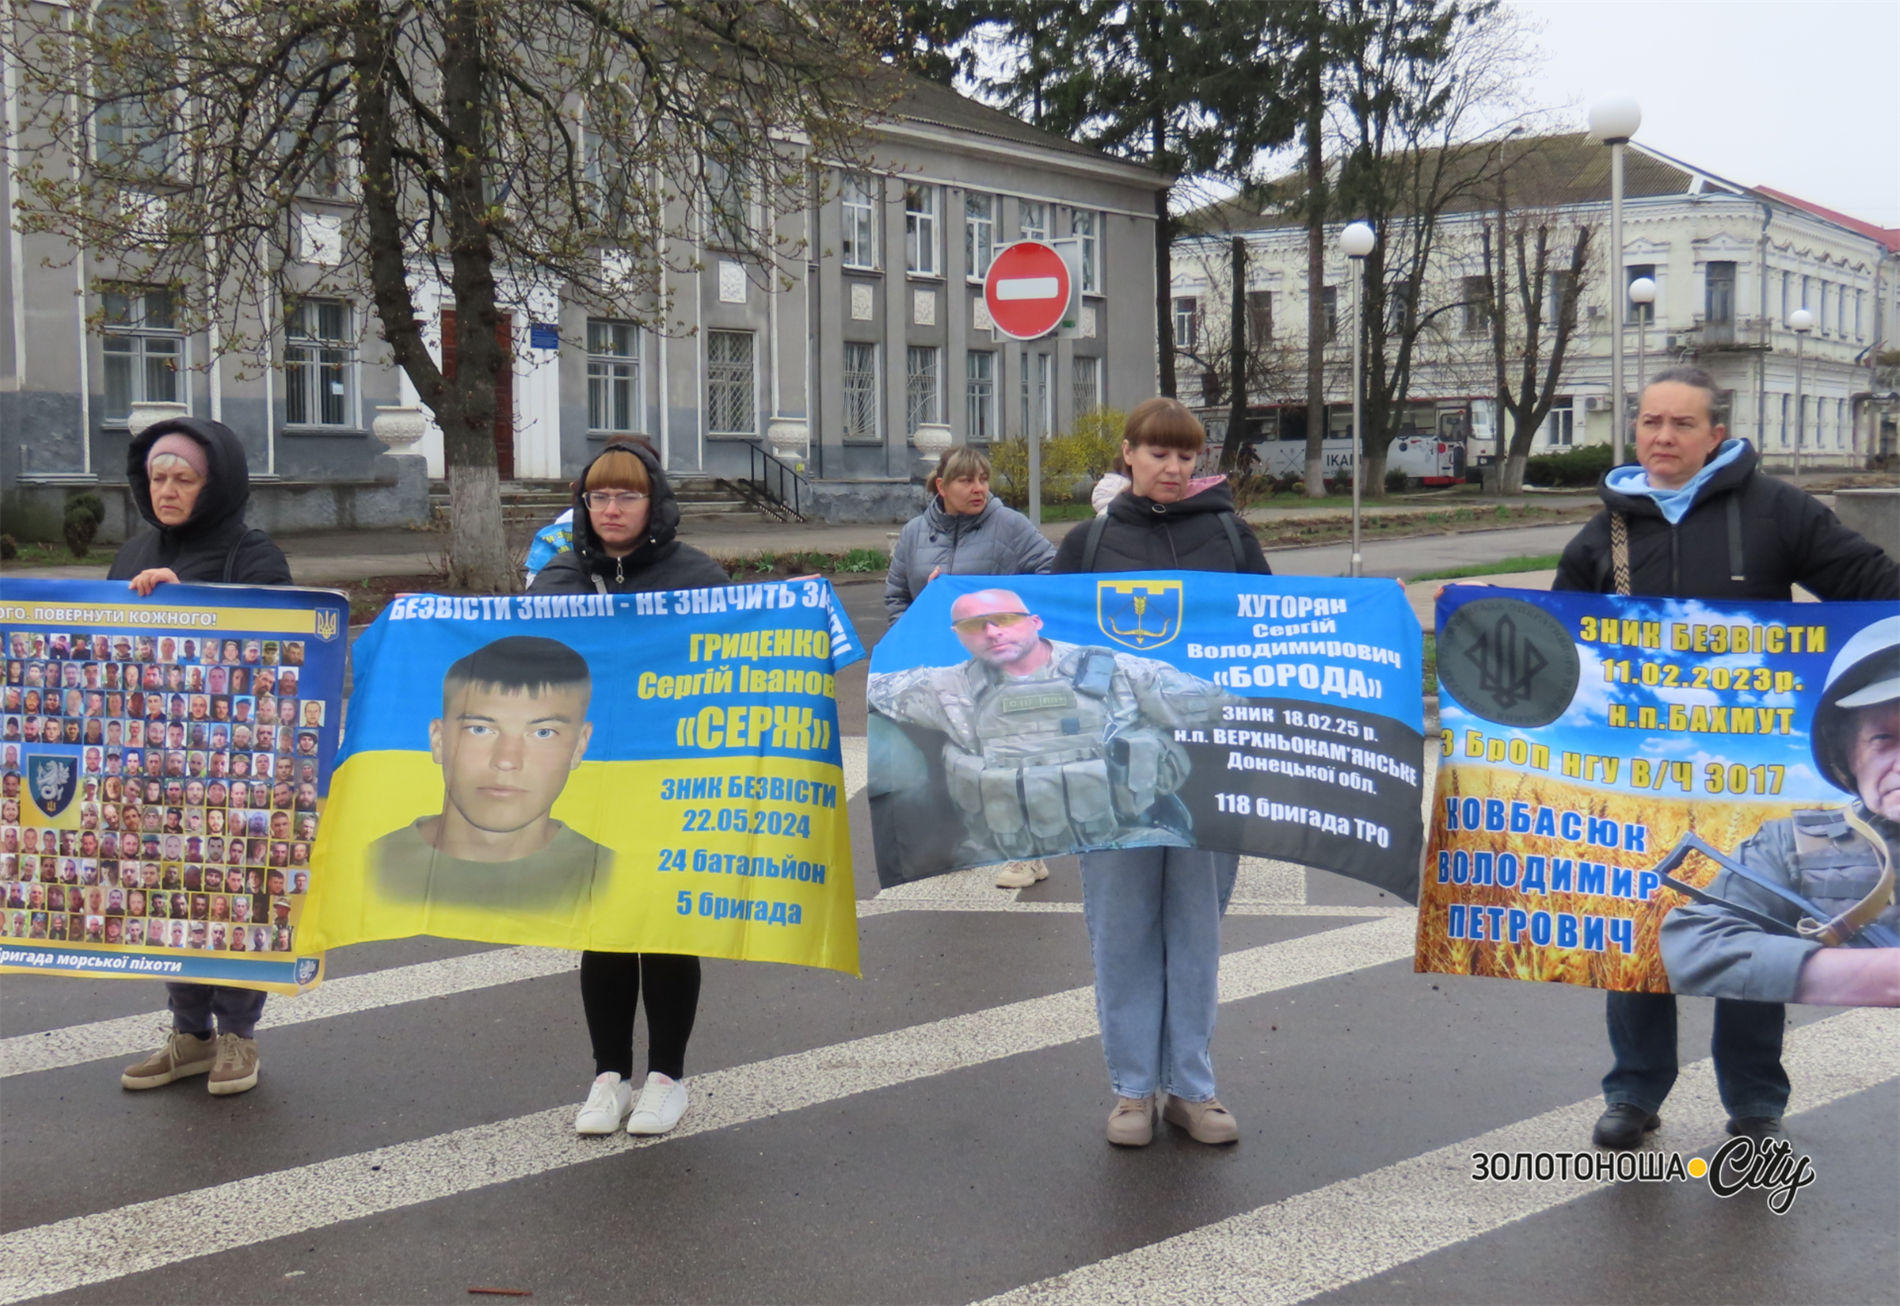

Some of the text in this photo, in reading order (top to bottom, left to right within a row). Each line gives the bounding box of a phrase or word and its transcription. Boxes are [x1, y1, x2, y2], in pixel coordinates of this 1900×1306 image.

[34, 606, 125, 623] ПОВЕРНУТИ
[129, 610, 218, 626] КОЖНОГО!
[389, 596, 511, 621] БЕЗВІСТИ
[517, 594, 615, 620] ЗНИКЛІ
[635, 591, 669, 616] НЕ
[673, 582, 796, 615] ЗНАЧИТЬ
[1237, 593, 1347, 618] ХУТОРЯН
[689, 628, 831, 662] ГРИЦЕНКО
[1252, 617, 1336, 638] Сергій
[1579, 615, 1827, 654] ЗНИК БЕЗВІСТИ
[1187, 640, 1402, 669] Володимирович
[637, 664, 733, 699] Сергій
[1213, 663, 1383, 699] «БОРОДА»
[1600, 658, 1804, 694] 11.02.2023р.
[676, 705, 831, 751] «СЕРЖ»
[1222, 705, 1379, 742] ЗНИК 18.02.25 р.
[1174, 728, 1418, 788] н.п. ВЕРХНЬОКАМ'ЯНСЬКЕ
[1227, 751, 1378, 795] Донецької обл.
[1630, 758, 1693, 792] В/Ч
[1704, 762, 1785, 795] 3017
[660, 775, 837, 809] ЗНИК БЕЗВІСТИ
[681, 808, 811, 839] 22.05.2024
[1214, 792, 1390, 849] 118 бригада ТРО
[1446, 796, 1647, 853] КОВБАСЮК
[657, 848, 826, 885] 24 батальйон
[1437, 850, 1660, 900] ВОЛОДИМИР
[676, 890, 803, 927] 5 бригада
[1448, 904, 1634, 954] ПЕТРОВИЧ
[56, 952, 127, 969] морської
[129, 956, 183, 972] піхоти
